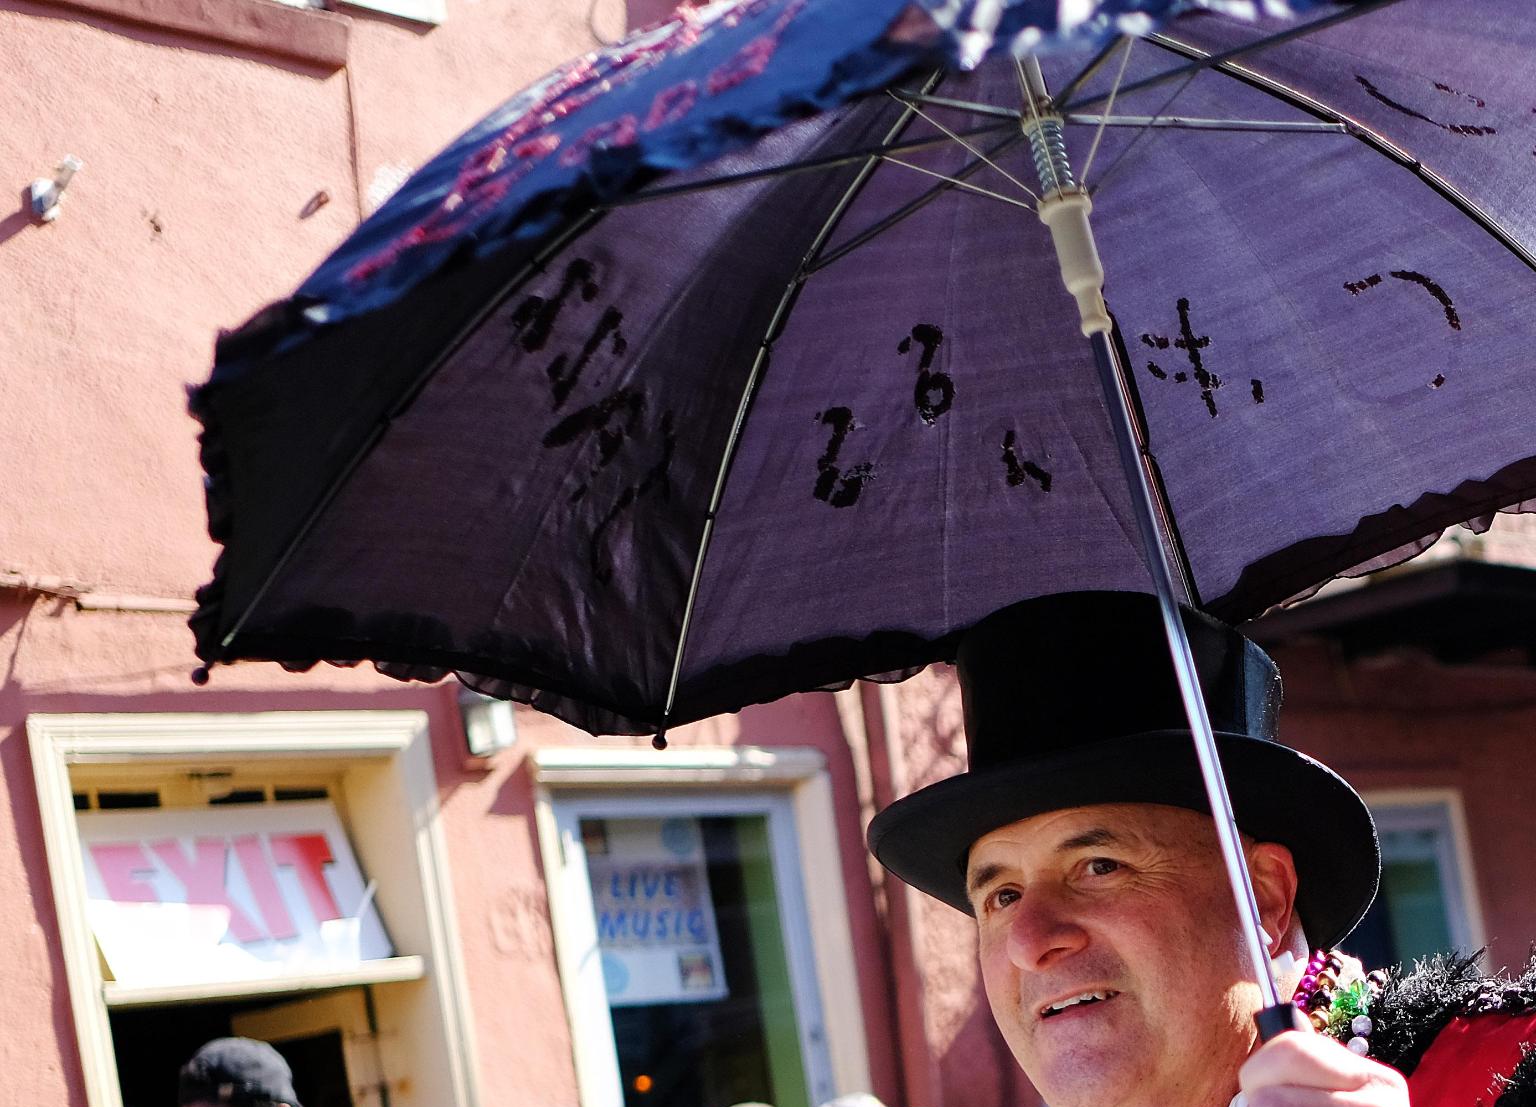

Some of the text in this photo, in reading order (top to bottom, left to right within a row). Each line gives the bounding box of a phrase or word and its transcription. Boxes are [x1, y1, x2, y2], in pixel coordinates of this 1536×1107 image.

[89, 832, 336, 940] EXIT
[610, 869, 680, 898] LIVE
[600, 908, 708, 944] MUSIC
